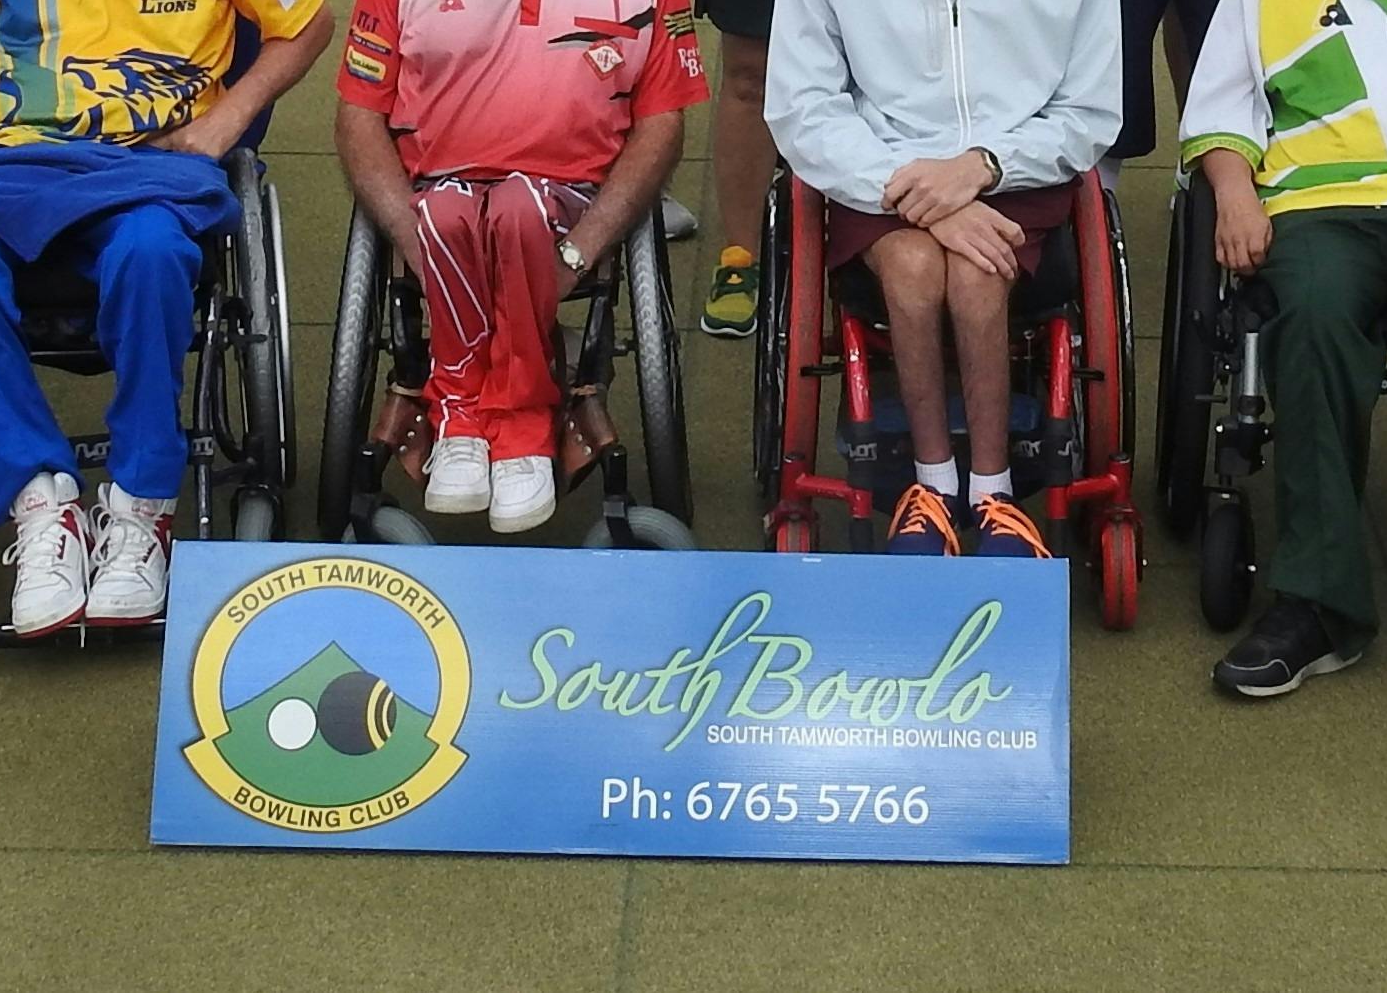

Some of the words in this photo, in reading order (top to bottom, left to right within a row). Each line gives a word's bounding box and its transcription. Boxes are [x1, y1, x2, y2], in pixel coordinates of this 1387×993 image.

[227, 568, 306, 624] SOUTH
[313, 564, 447, 629] TAMWORTH
[499, 591, 773, 752] South
[727, 600, 1013, 726] Bowlo
[706, 724, 773, 746] SOUTH
[778, 725, 888, 748] TAMWORTH
[891, 727, 982, 750] BOWLING
[986, 729, 1038, 750] CLUB
[233, 785, 341, 828] BOWLING
[349, 790, 411, 826] CLUB
[600, 778, 672, 820] Ph:
[685, 782, 798, 823] 6765
[816, 784, 930, 824] 5766
